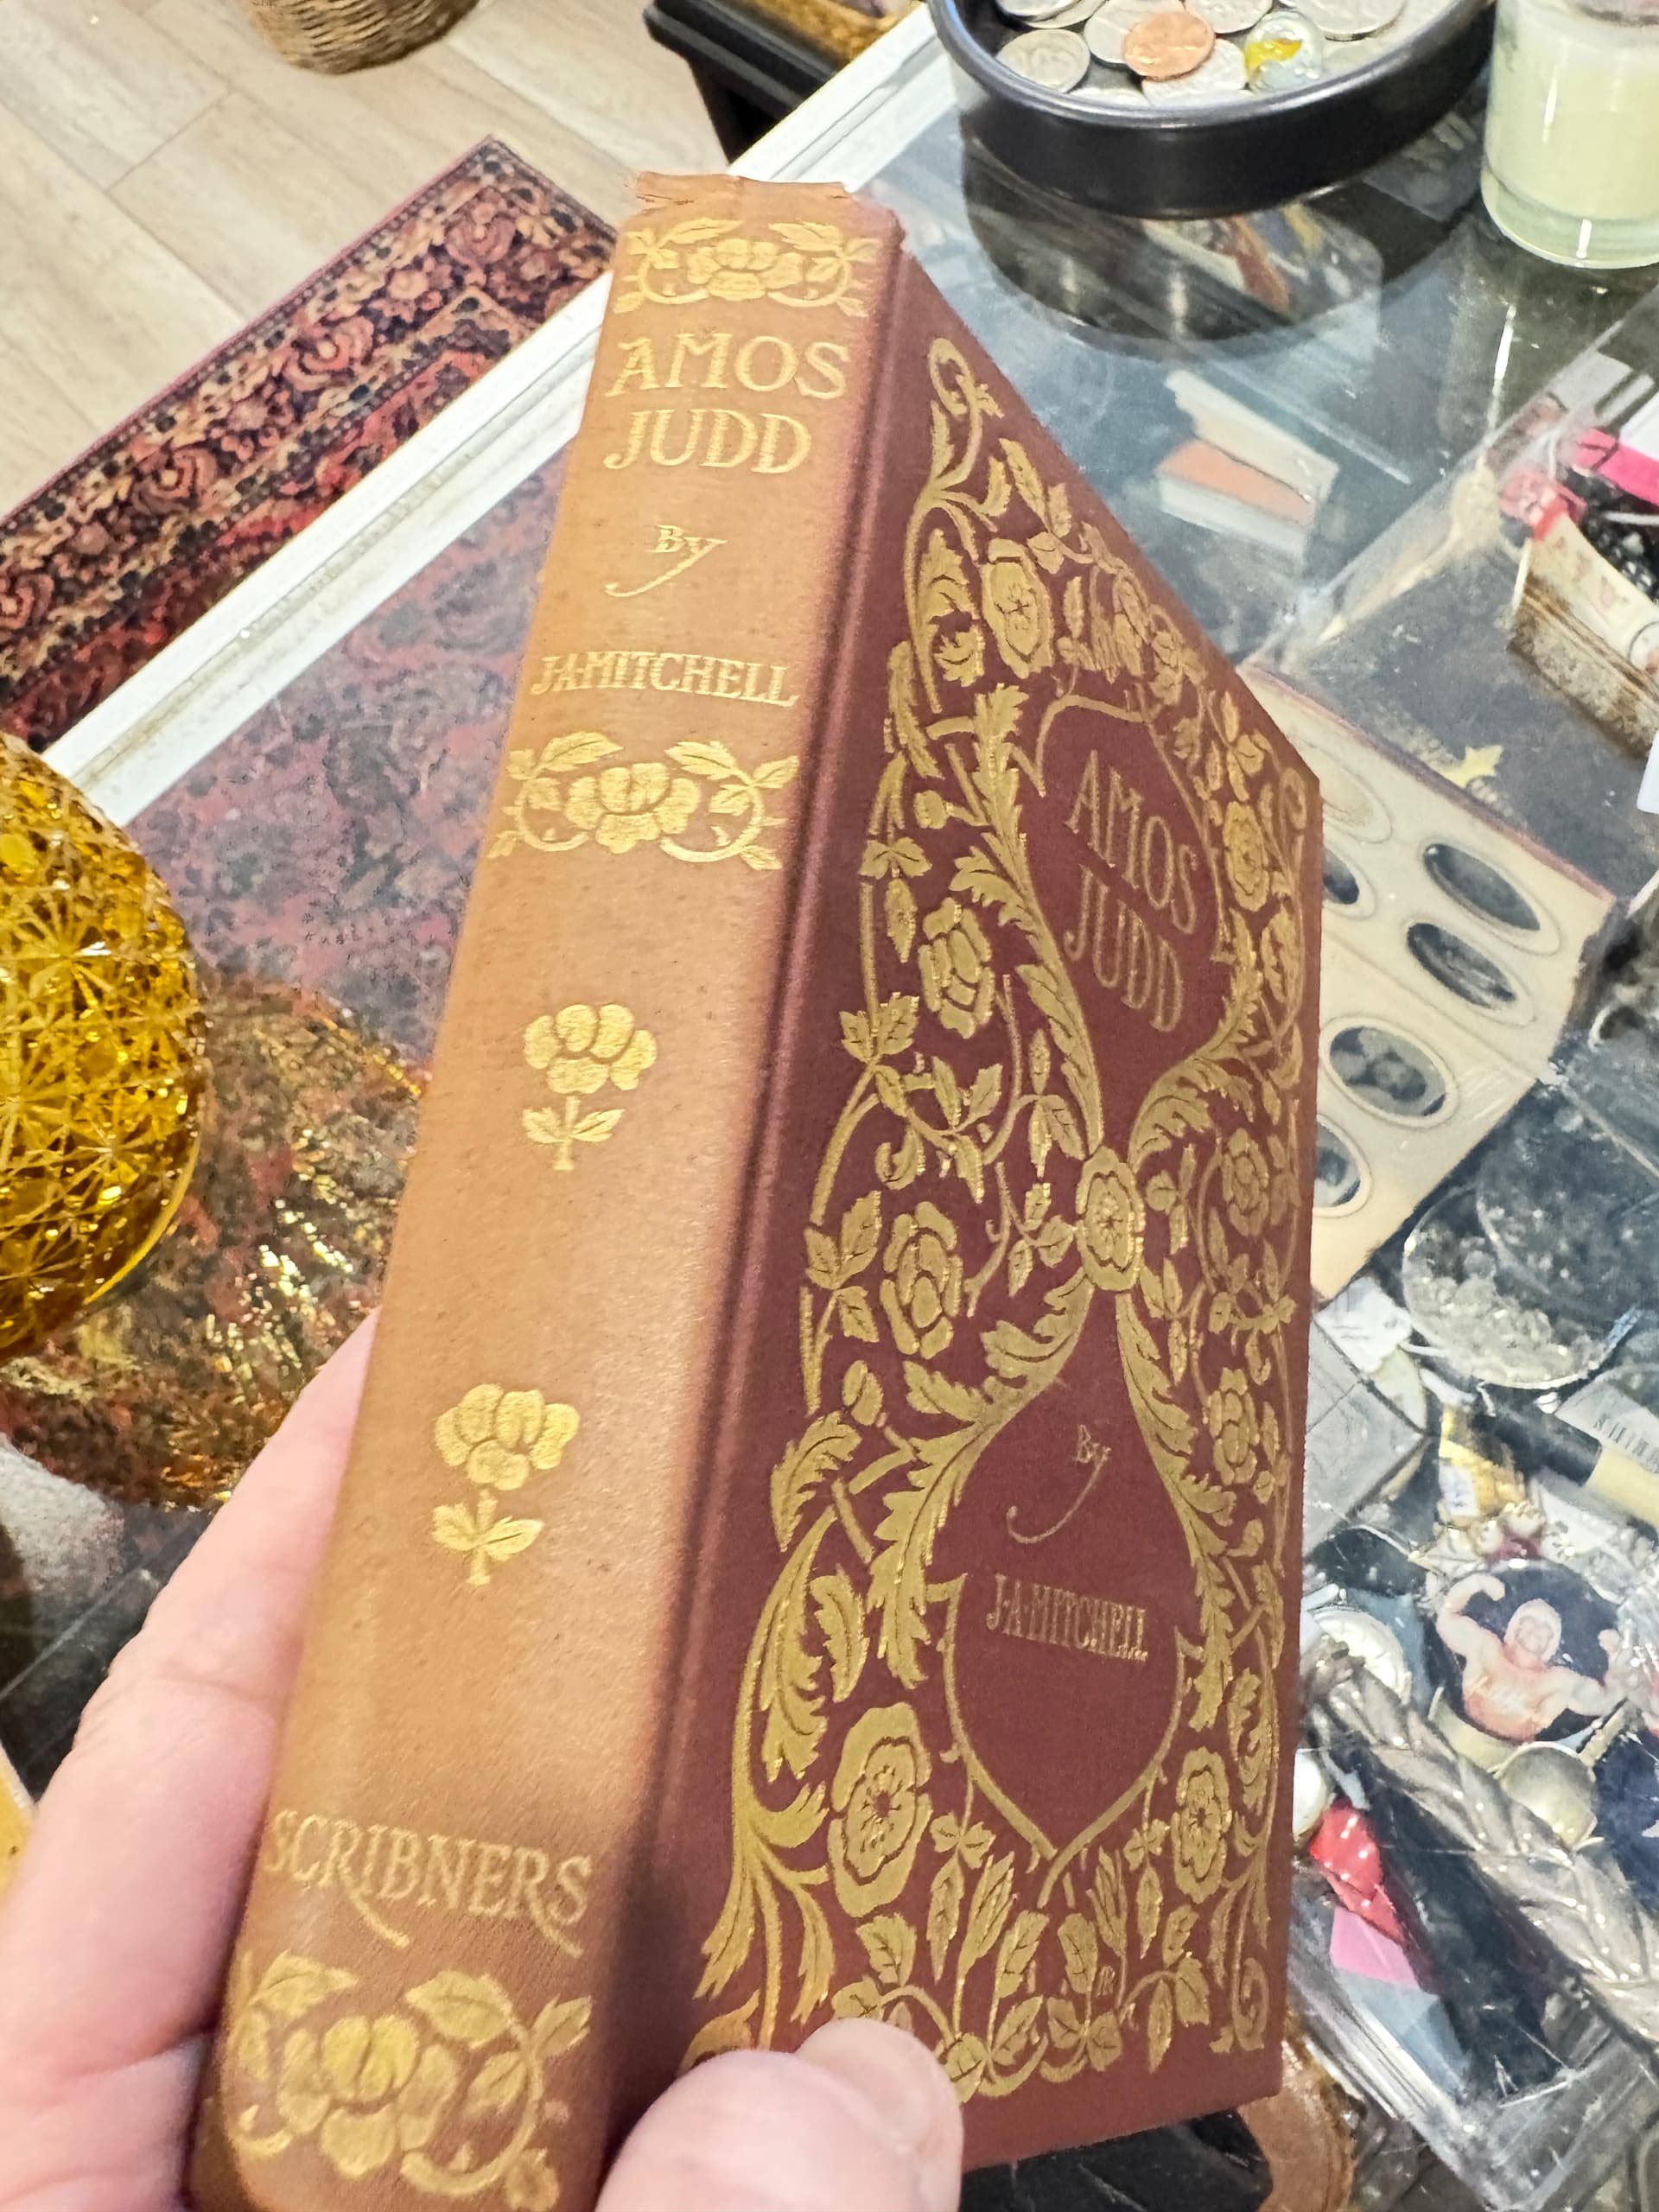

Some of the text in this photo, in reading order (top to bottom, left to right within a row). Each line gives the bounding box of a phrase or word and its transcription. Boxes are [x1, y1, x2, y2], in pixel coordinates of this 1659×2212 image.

[605, 334, 852, 399] AMOS
[603, 410, 812, 474] JUDD
[606, 524, 728, 597] By
[1064, 749, 1198, 934] AMOS
[1064, 863, 1184, 1032] JUDD
[1007, 1424, 1112, 1544] By
[263, 1809, 592, 1958] SCRIBNERS
